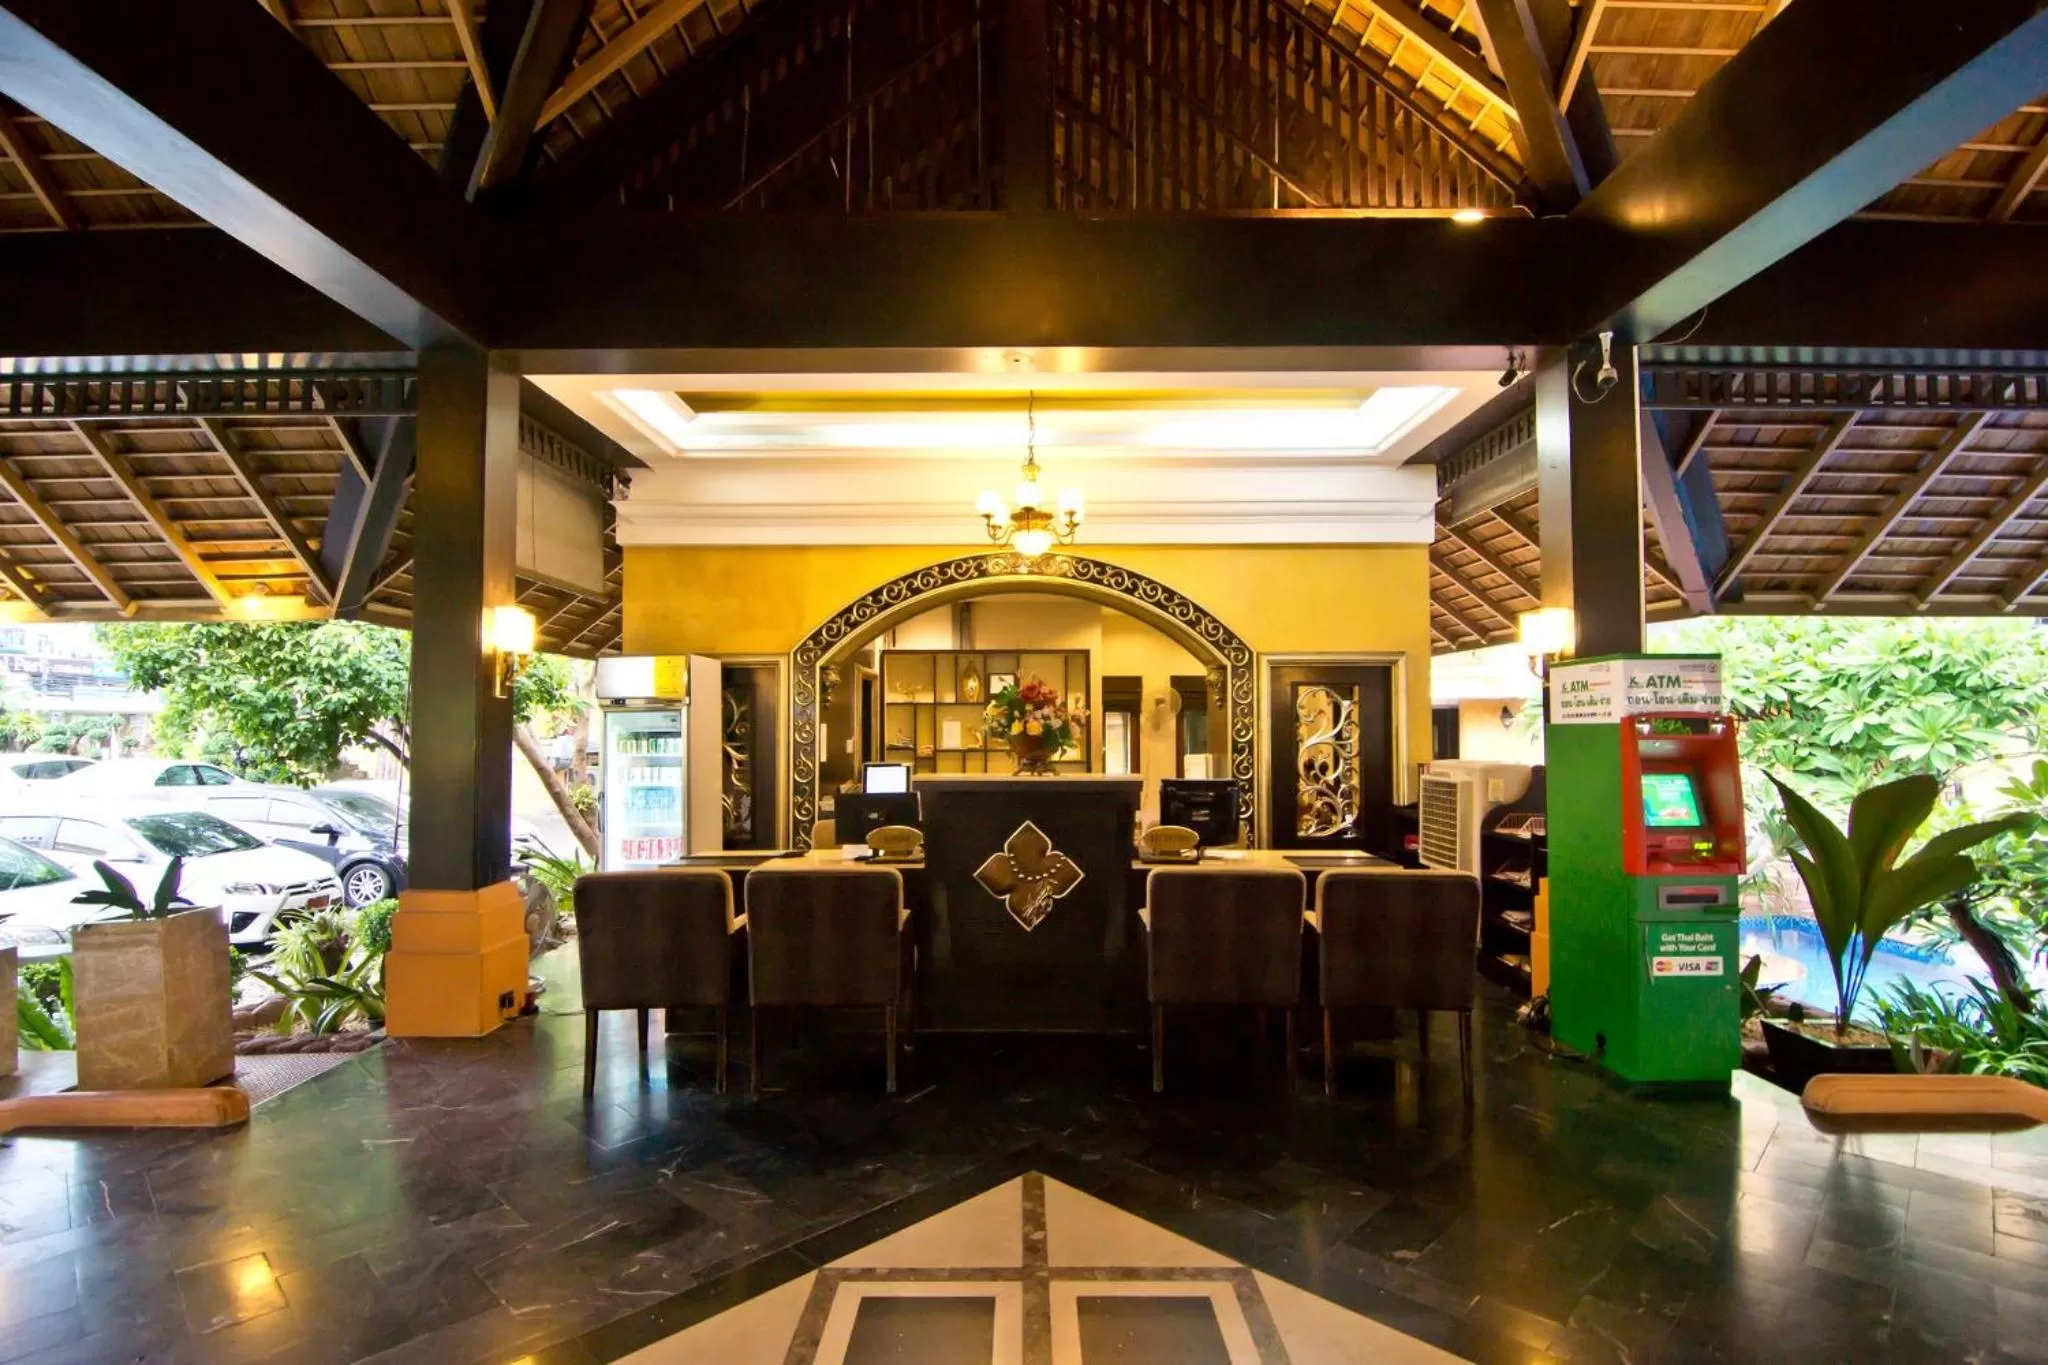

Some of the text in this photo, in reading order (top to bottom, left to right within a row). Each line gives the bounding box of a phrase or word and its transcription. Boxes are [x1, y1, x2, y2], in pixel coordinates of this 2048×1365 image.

[1571, 680, 1589, 693] ATM
[1646, 675, 1682, 688] ATM
[1660, 943, 1677, 952] with
[1679, 963, 1701, 971] VISA
